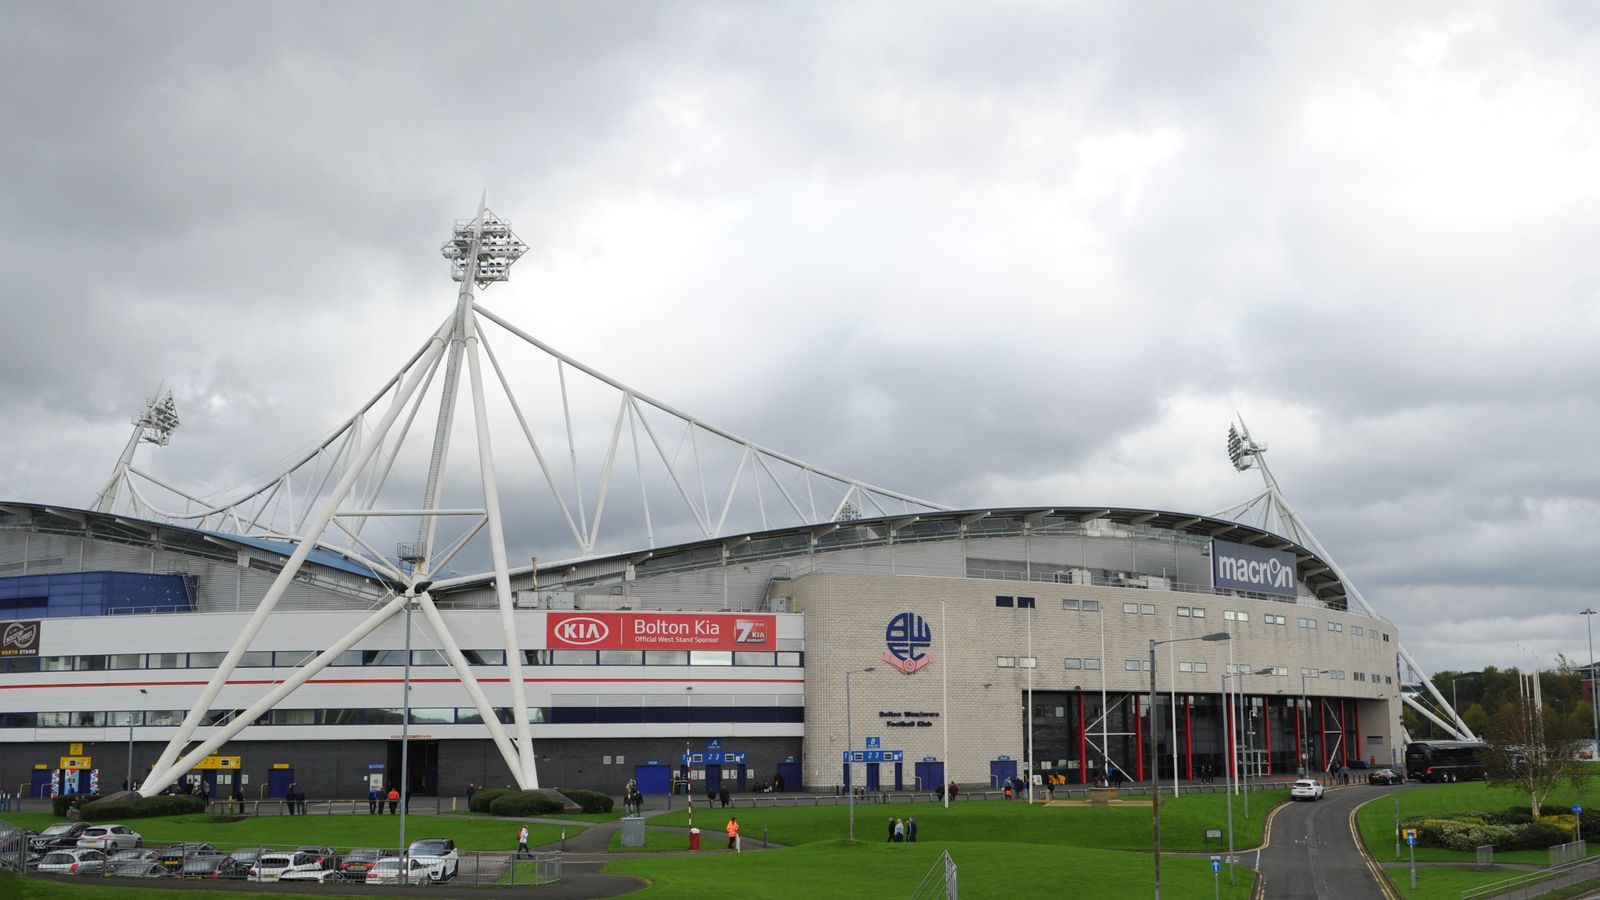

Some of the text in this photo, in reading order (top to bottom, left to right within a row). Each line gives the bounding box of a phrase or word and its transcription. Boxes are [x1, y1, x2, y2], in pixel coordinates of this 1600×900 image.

[1219, 555, 1293, 588] macron
[564, 624, 600, 638] KIA
[634, 619, 720, 634] Bolton Kia
[736, 622, 754, 642] 7
